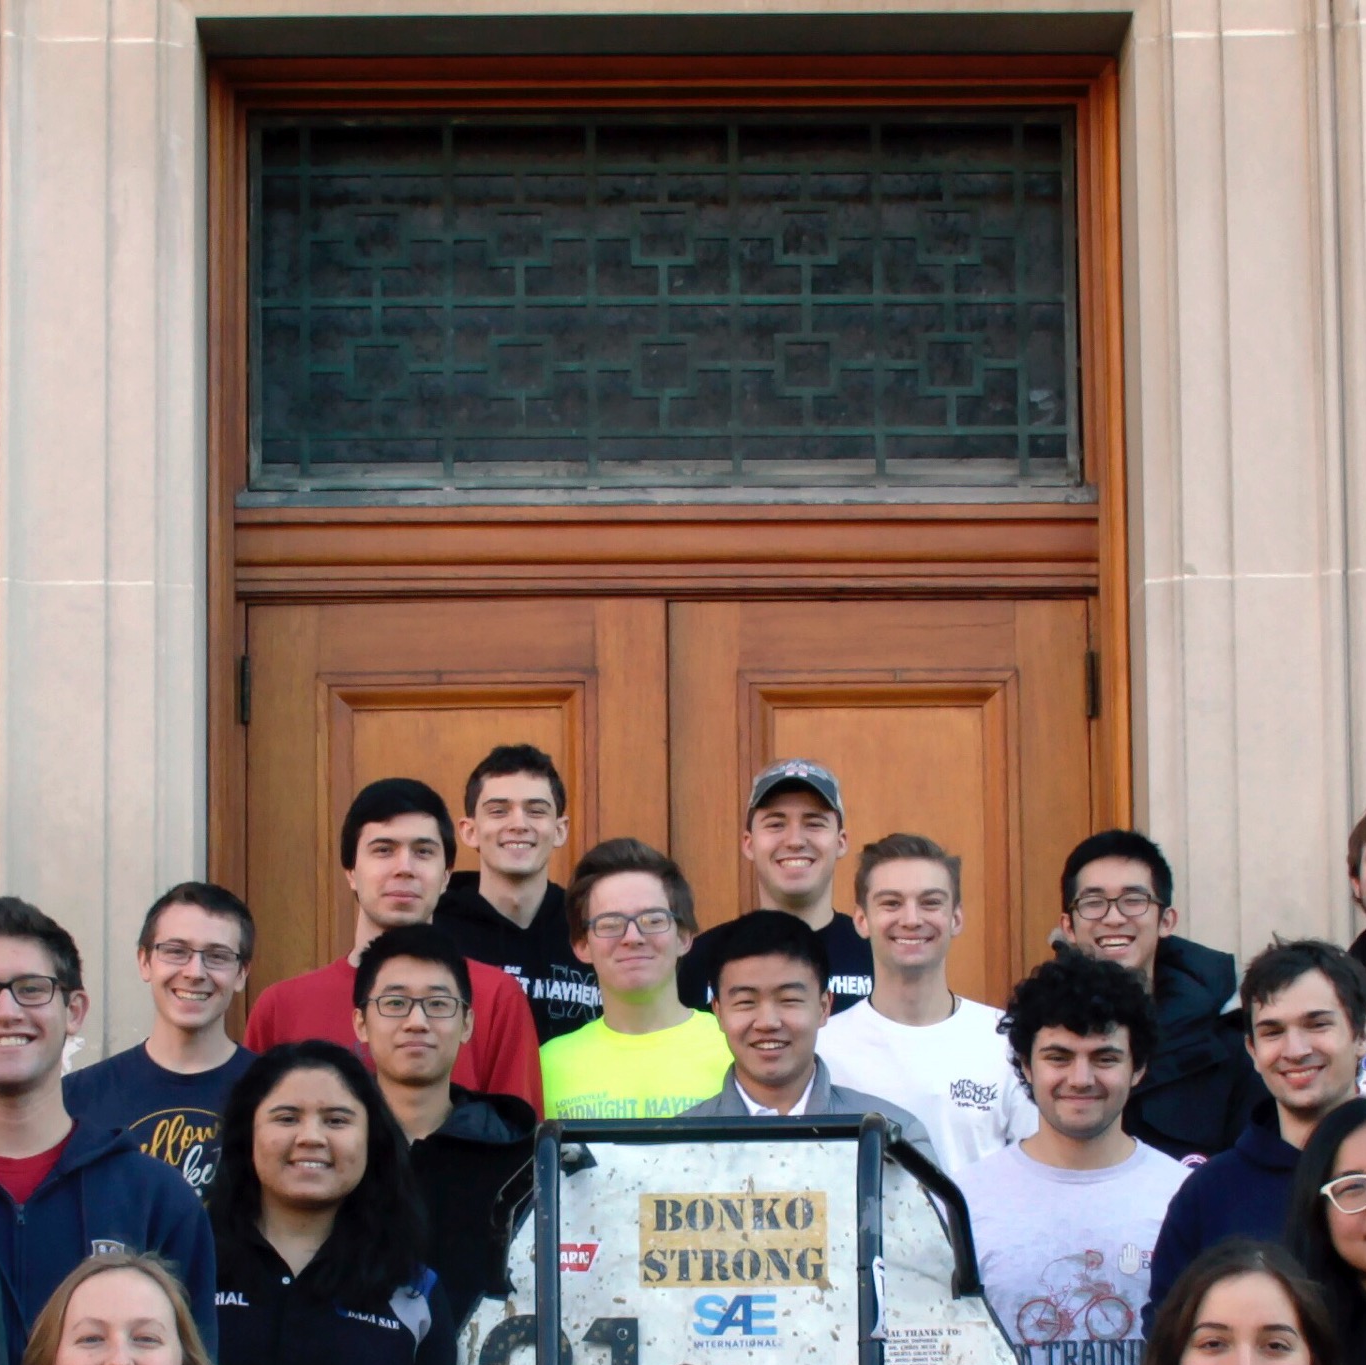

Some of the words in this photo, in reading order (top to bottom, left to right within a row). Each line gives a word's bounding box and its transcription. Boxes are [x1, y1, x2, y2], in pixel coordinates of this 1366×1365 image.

[557, 1099, 638, 1119] MIDNIGHT
[653, 1198, 814, 1232] BONKO
[560, 1251, 590, 1264] ARN
[643, 1247, 825, 1282] STRONG
[692, 1294, 778, 1336] SAE
[904, 1328, 943, 1337] THANKS
[693, 1340, 778, 1349] INTERNATIONAL
